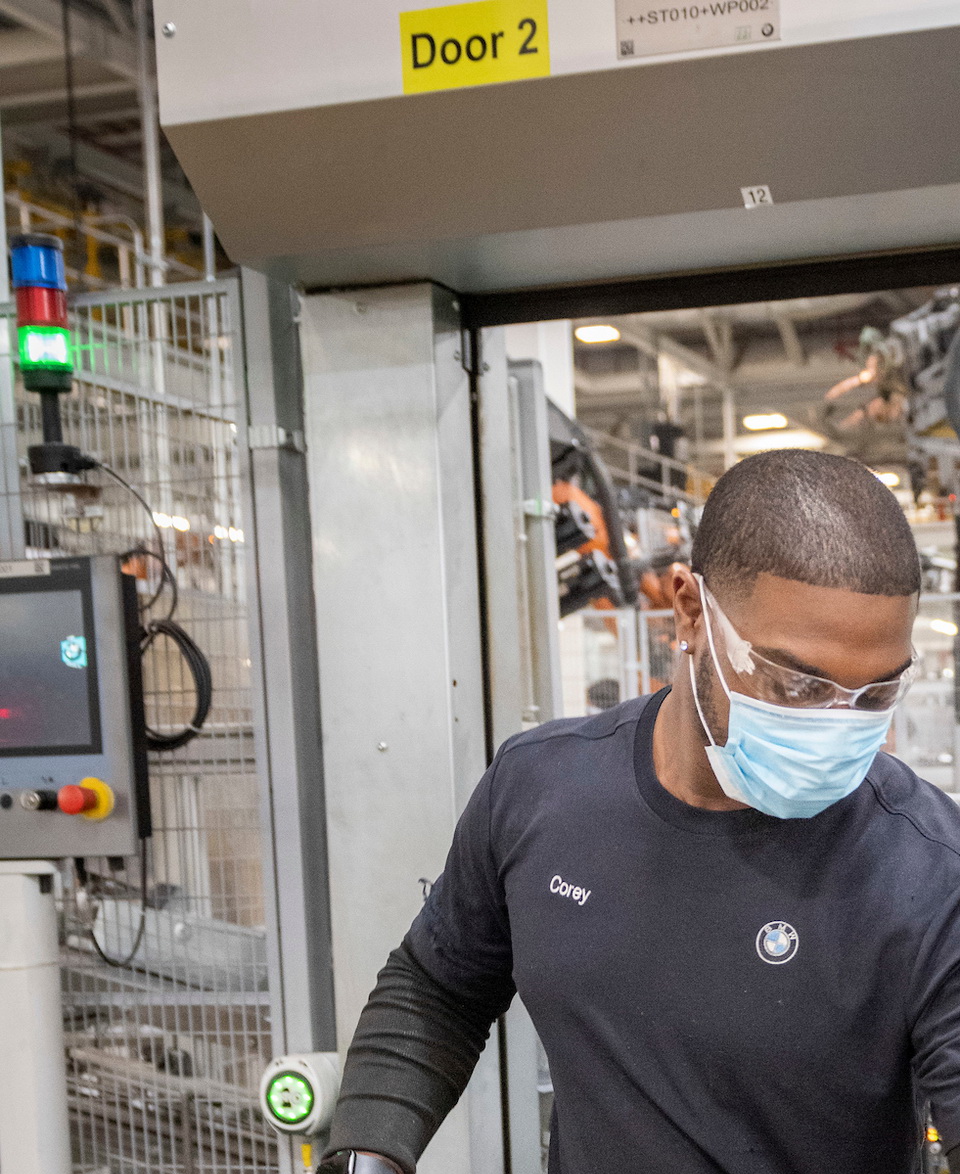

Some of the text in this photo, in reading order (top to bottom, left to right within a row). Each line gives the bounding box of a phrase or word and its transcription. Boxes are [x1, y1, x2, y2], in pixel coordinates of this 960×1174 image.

[410, 18, 539, 70] Door 2
[748, 188, 767, 204] 12
[549, 875, 591, 906] Corey
